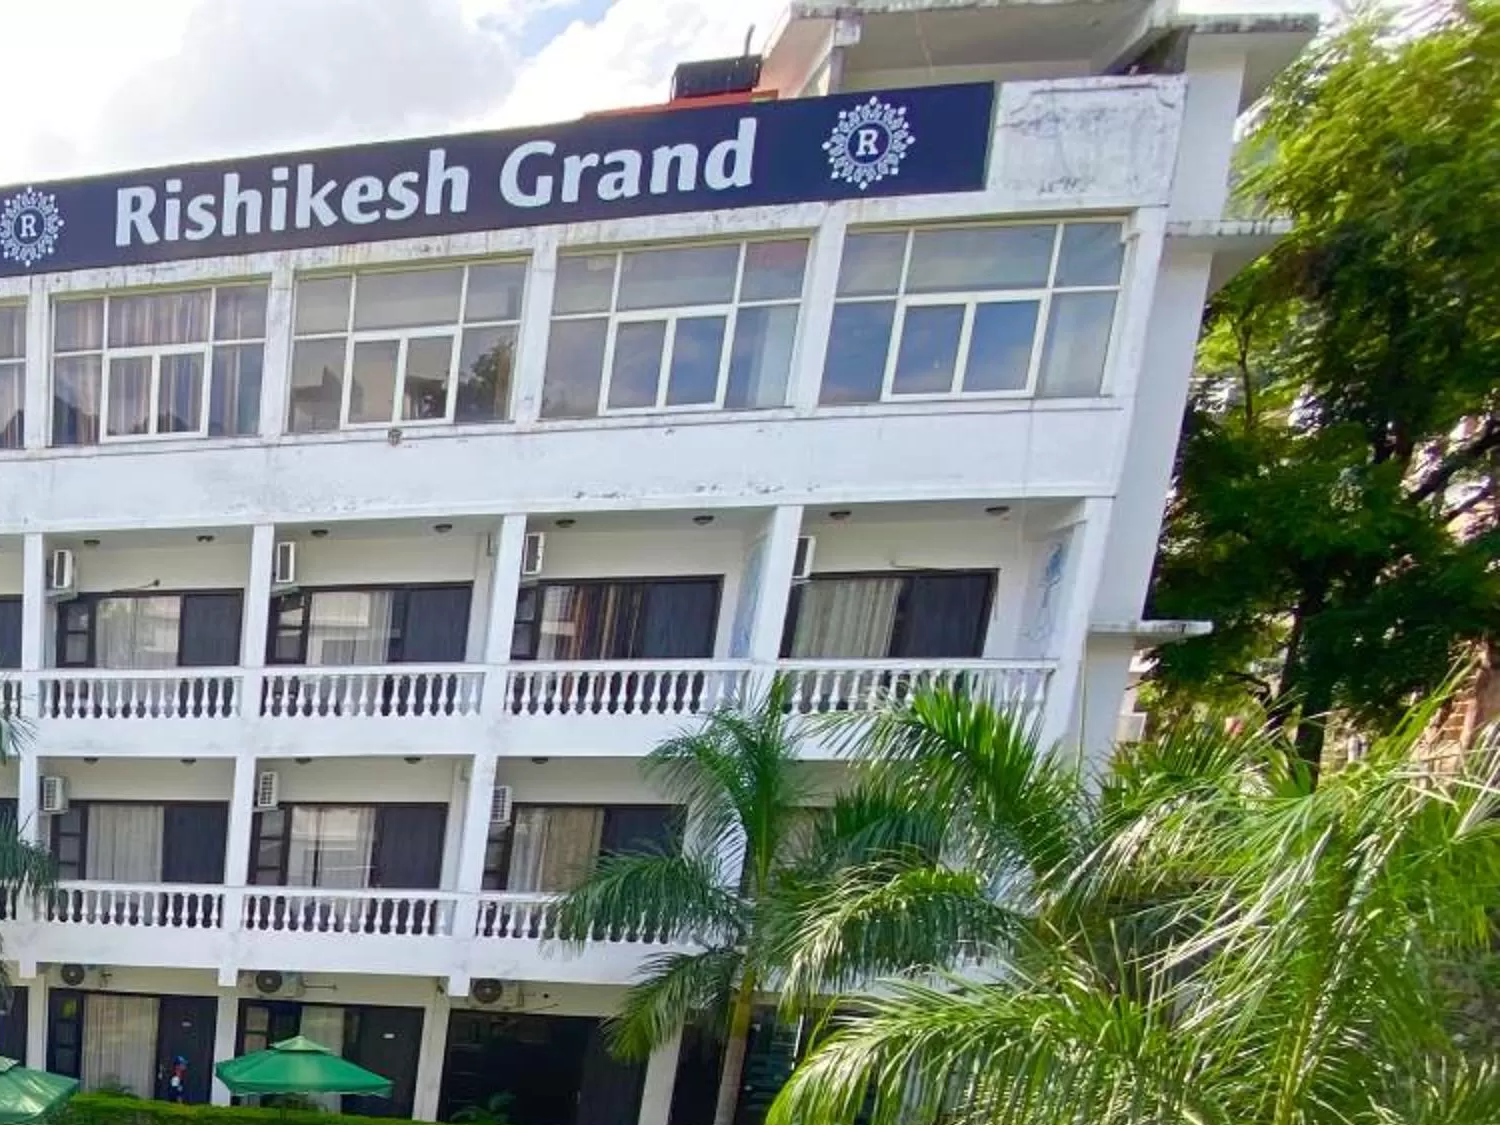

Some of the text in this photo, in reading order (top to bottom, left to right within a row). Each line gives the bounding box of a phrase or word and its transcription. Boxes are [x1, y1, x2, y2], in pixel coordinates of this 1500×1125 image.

[855, 129, 879, 156] R
[115, 116, 757, 247] Rishikesh Grand
[19, 214, 37, 238] R
